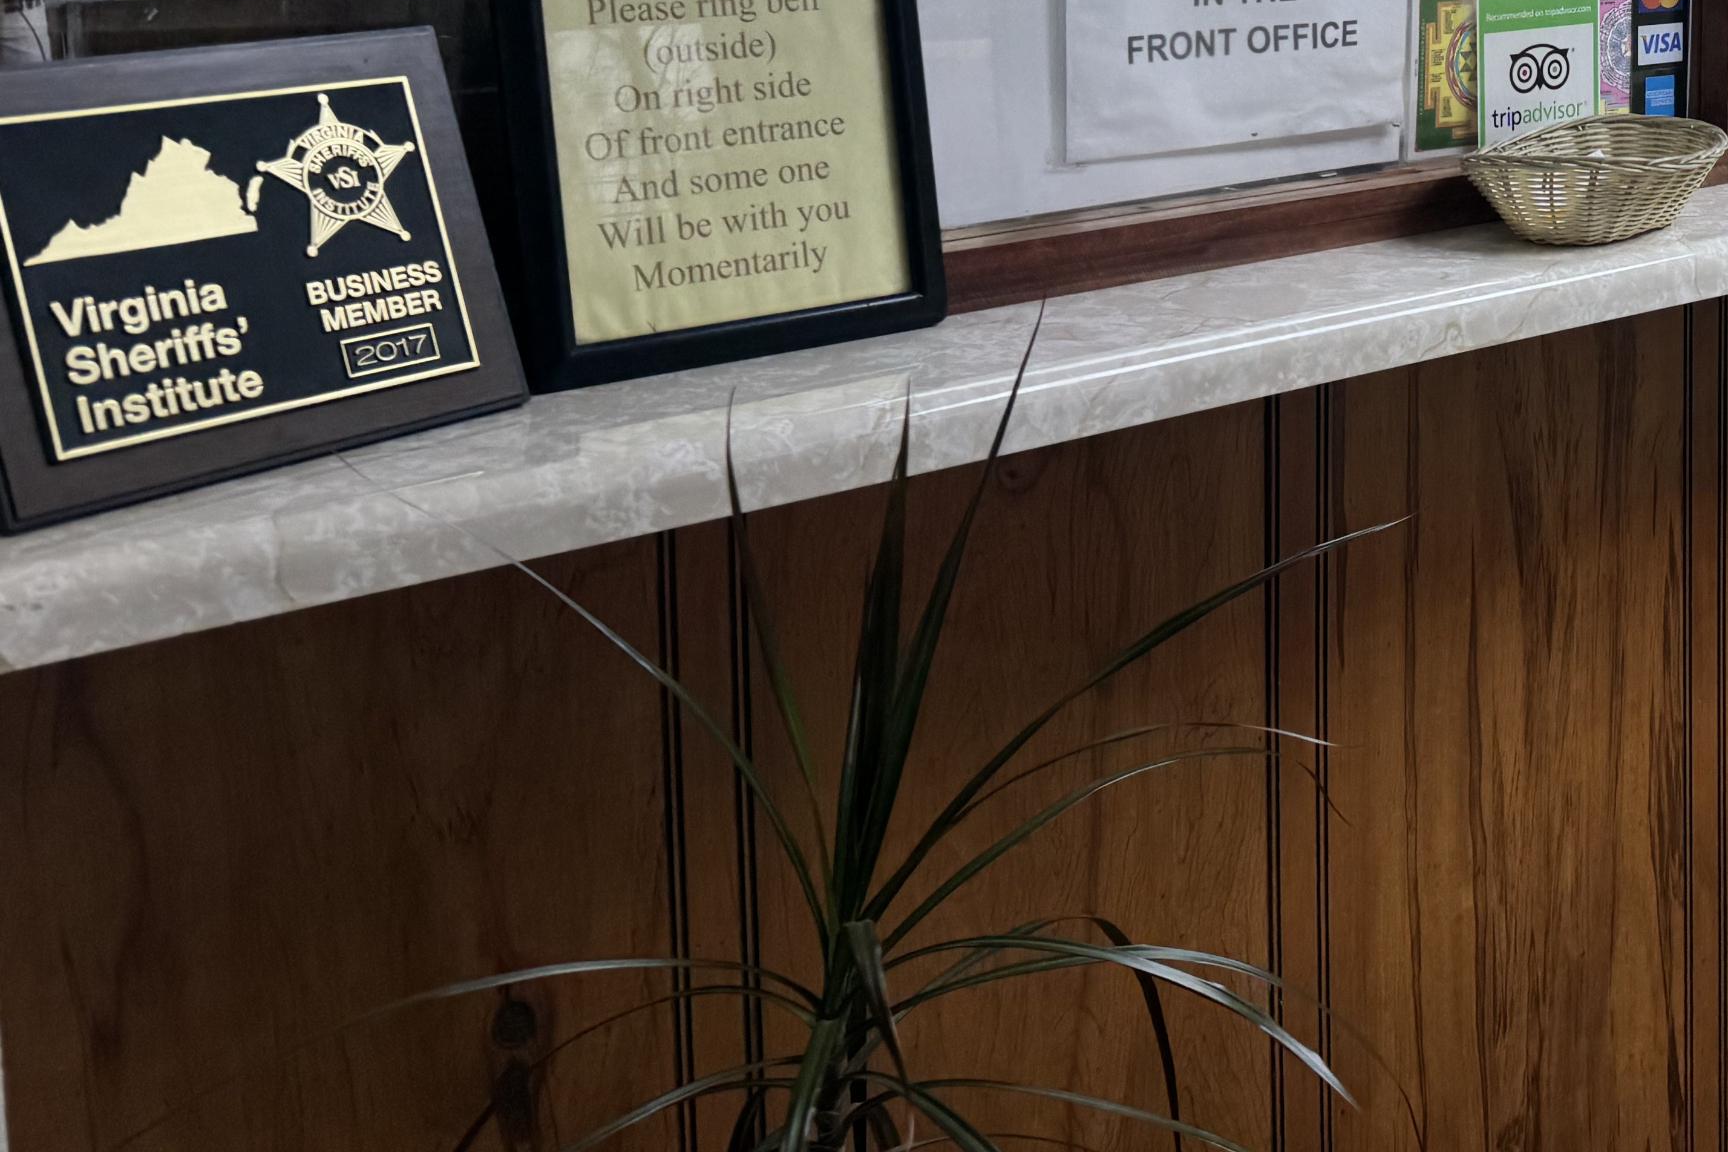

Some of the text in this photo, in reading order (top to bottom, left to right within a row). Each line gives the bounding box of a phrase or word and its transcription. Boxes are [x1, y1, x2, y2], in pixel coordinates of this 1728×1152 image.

[643, 30, 777, 74] (outside)
[1127, 20, 1358, 64] FRONT OFFICE
[1642, 31, 1682, 55] VISA
[614, 72, 812, 114] On right side
[299, 124, 365, 149] VIRGINIA
[584, 114, 846, 162] Of front entrance
[1492, 102, 1583, 131] tripadvisor
[312, 181, 381, 215] INSTITUTE
[613, 159, 831, 205] And some one
[598, 199, 851, 249] Will be with you
[306, 260, 443, 306] BUSINESS
[633, 242, 828, 293] Momentarily
[49, 279, 228, 337] Virginia
[320, 289, 443, 332] MEMBER
[65, 316, 249, 385] Sheriffs'
[354, 334, 427, 367] 2017
[76, 368, 264, 434] Institute
